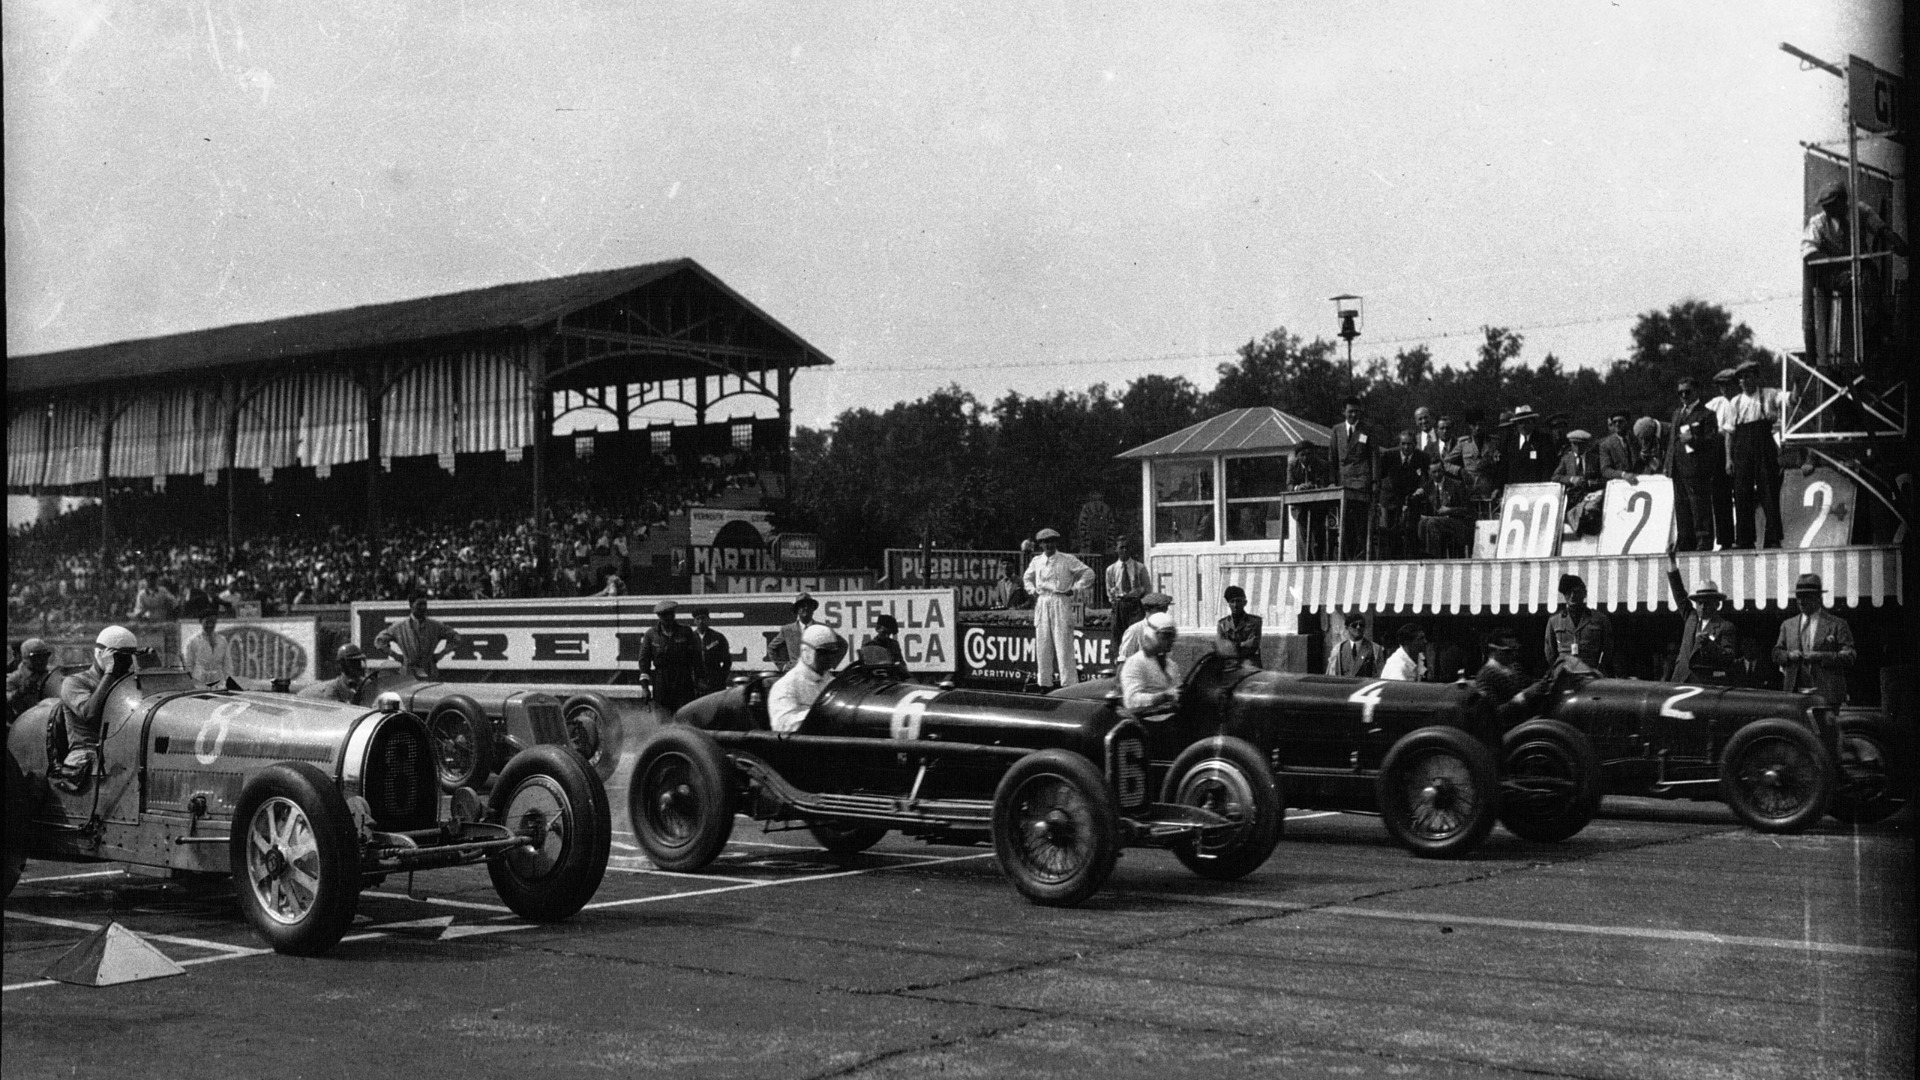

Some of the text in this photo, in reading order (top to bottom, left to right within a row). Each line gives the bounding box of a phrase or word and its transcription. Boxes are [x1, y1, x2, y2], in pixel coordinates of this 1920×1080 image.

[1497, 494, 1559, 558] 60
[1621, 490, 1652, 555] 2
[1800, 481, 1833, 547] 2
[825, 598, 945, 628] STELLA
[971, 669, 1021, 679] APERITIVO
[1349, 681, 1389, 722] 4
[1661, 686, 1705, 719] 2
[195, 701, 251, 765] 8
[890, 690, 941, 740] 6
[384, 732, 418, 815] 8
[1118, 739, 1146, 807] 6
